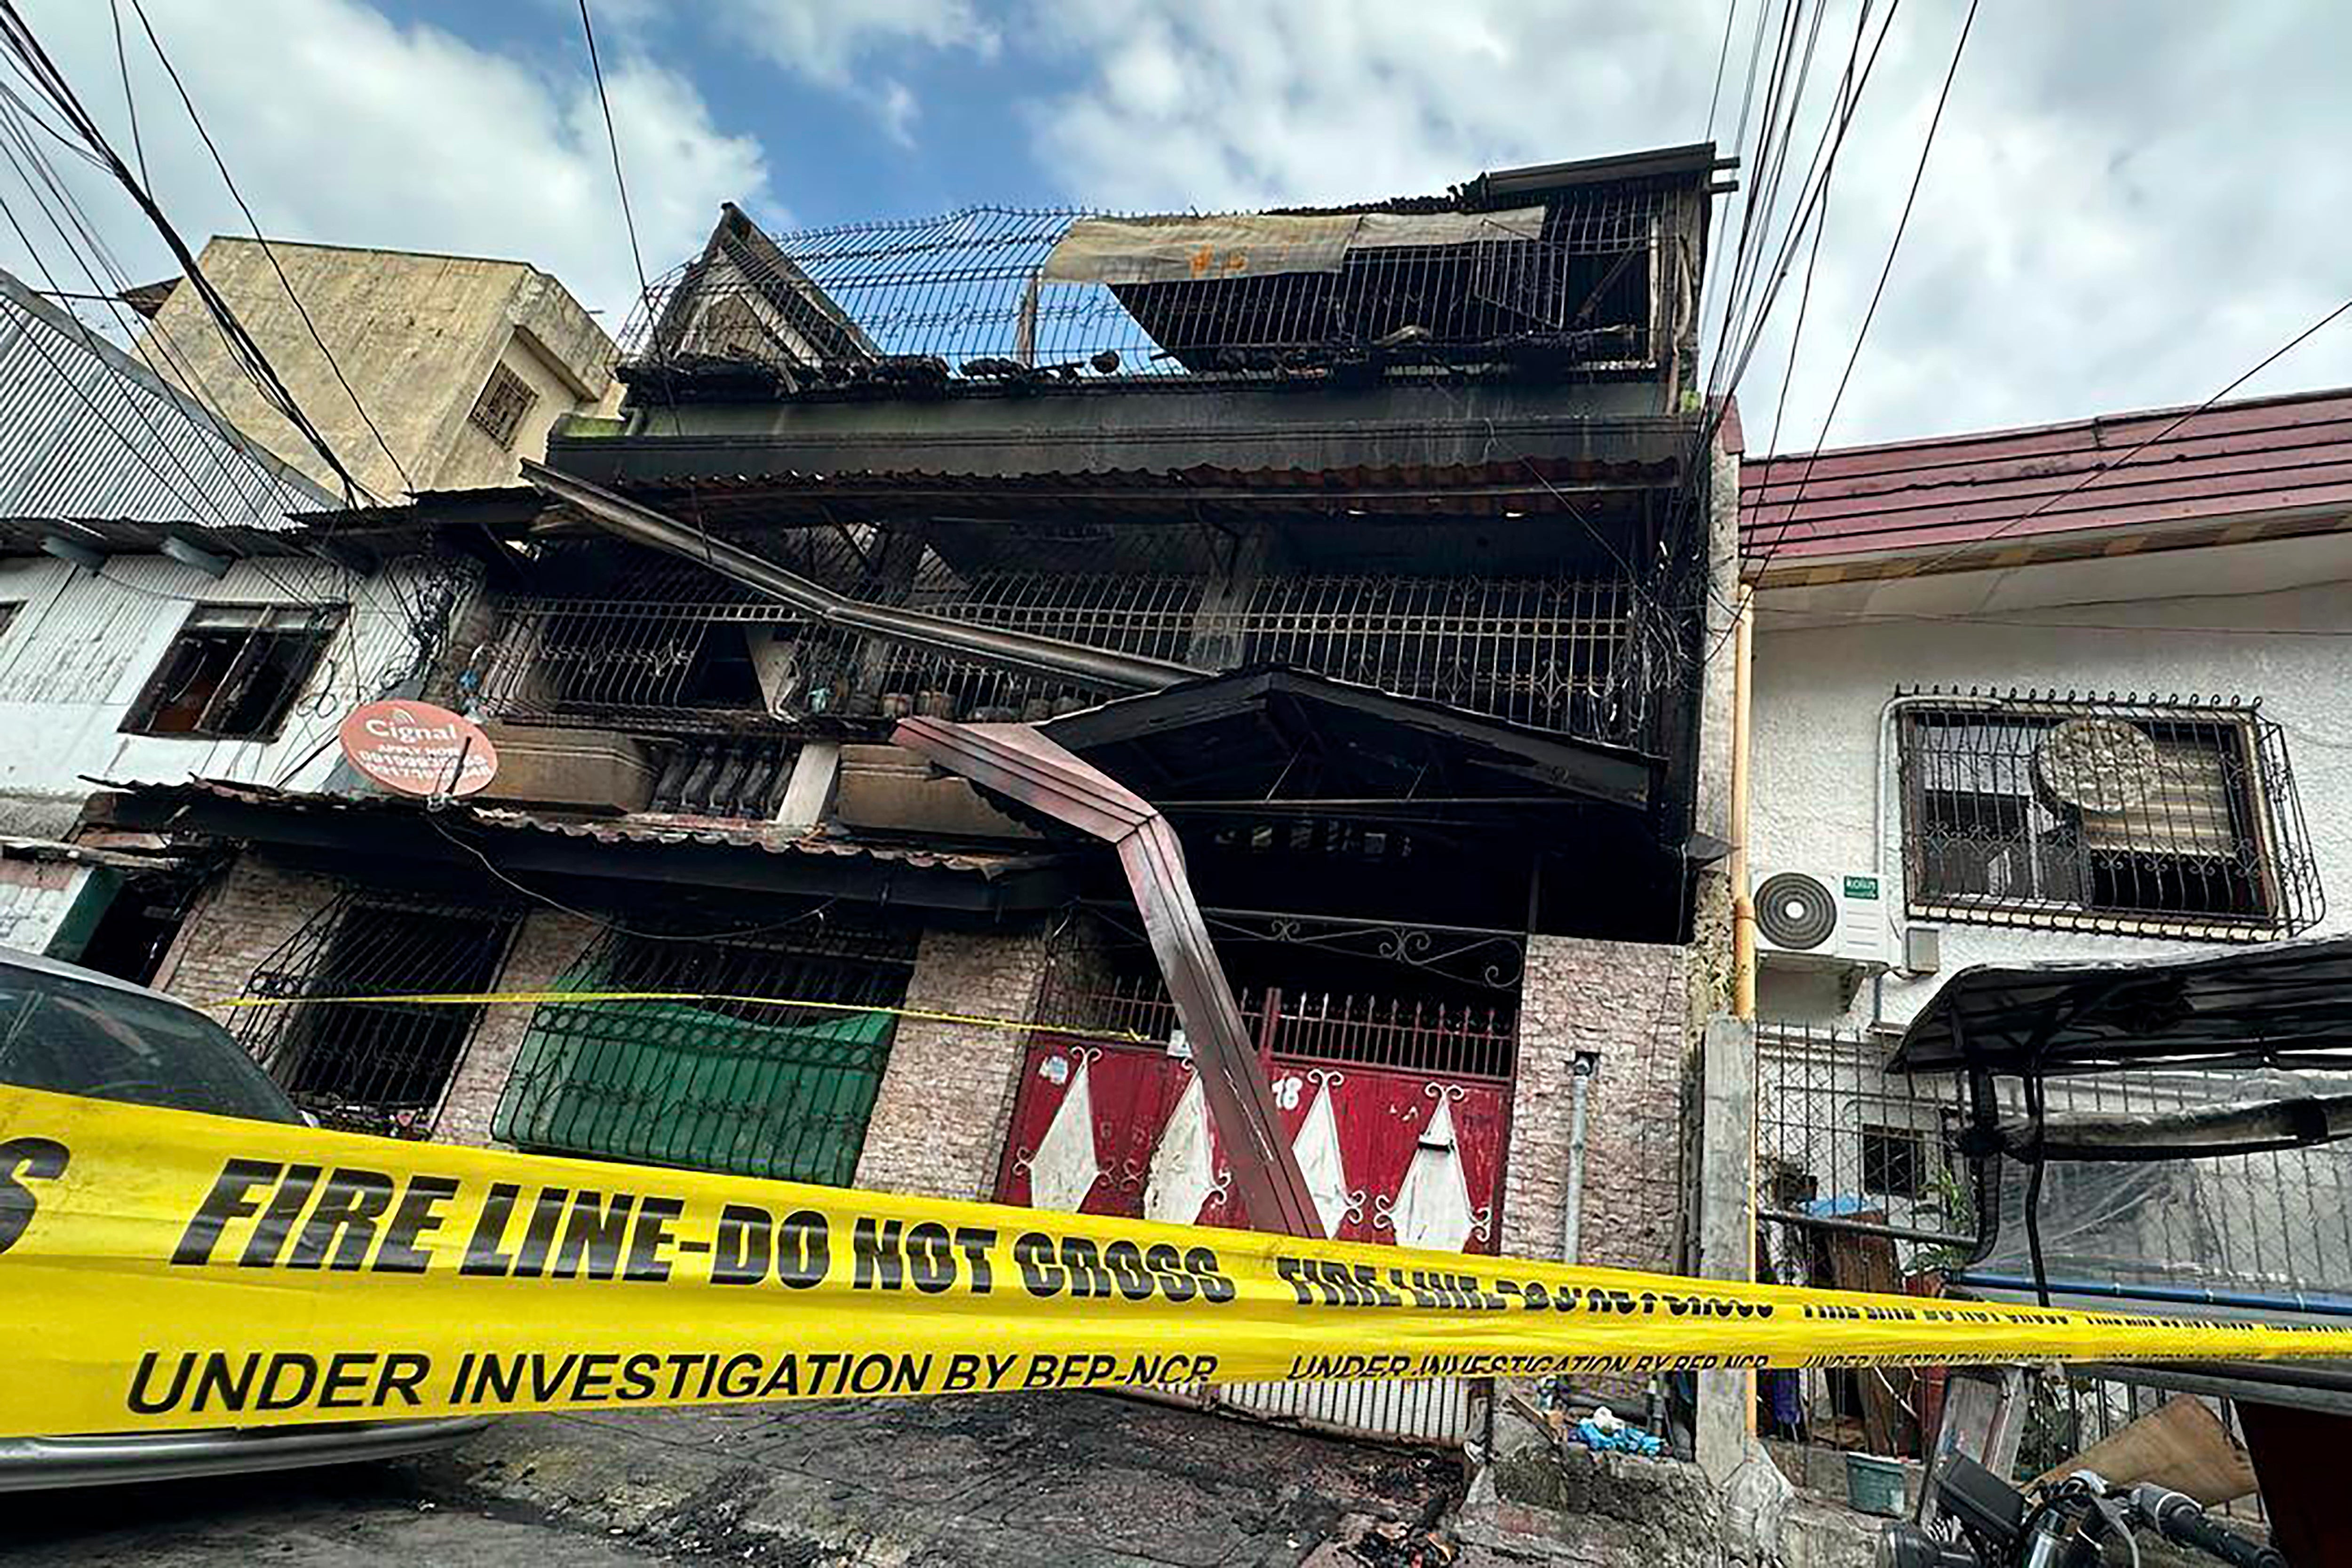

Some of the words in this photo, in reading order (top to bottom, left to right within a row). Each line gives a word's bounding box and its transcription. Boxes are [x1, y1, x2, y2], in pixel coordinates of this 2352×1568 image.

[366, 720, 456, 743] Cignal
[1271, 1072, 1303, 1110] 18
[170, 1158, 460, 1274] FIRE
[853, 1218, 997, 1293] NOT
[1014, 1232, 1235, 1304] CROSS
[128, 1353, 430, 1414] UNDER
[449, 1353, 932, 1404] INVESTIGATION
[942, 1354, 1018, 1390] BY
[1022, 1354, 1218, 1387] BFP-NCR
[1287, 1355, 1411, 1379] UNDER
